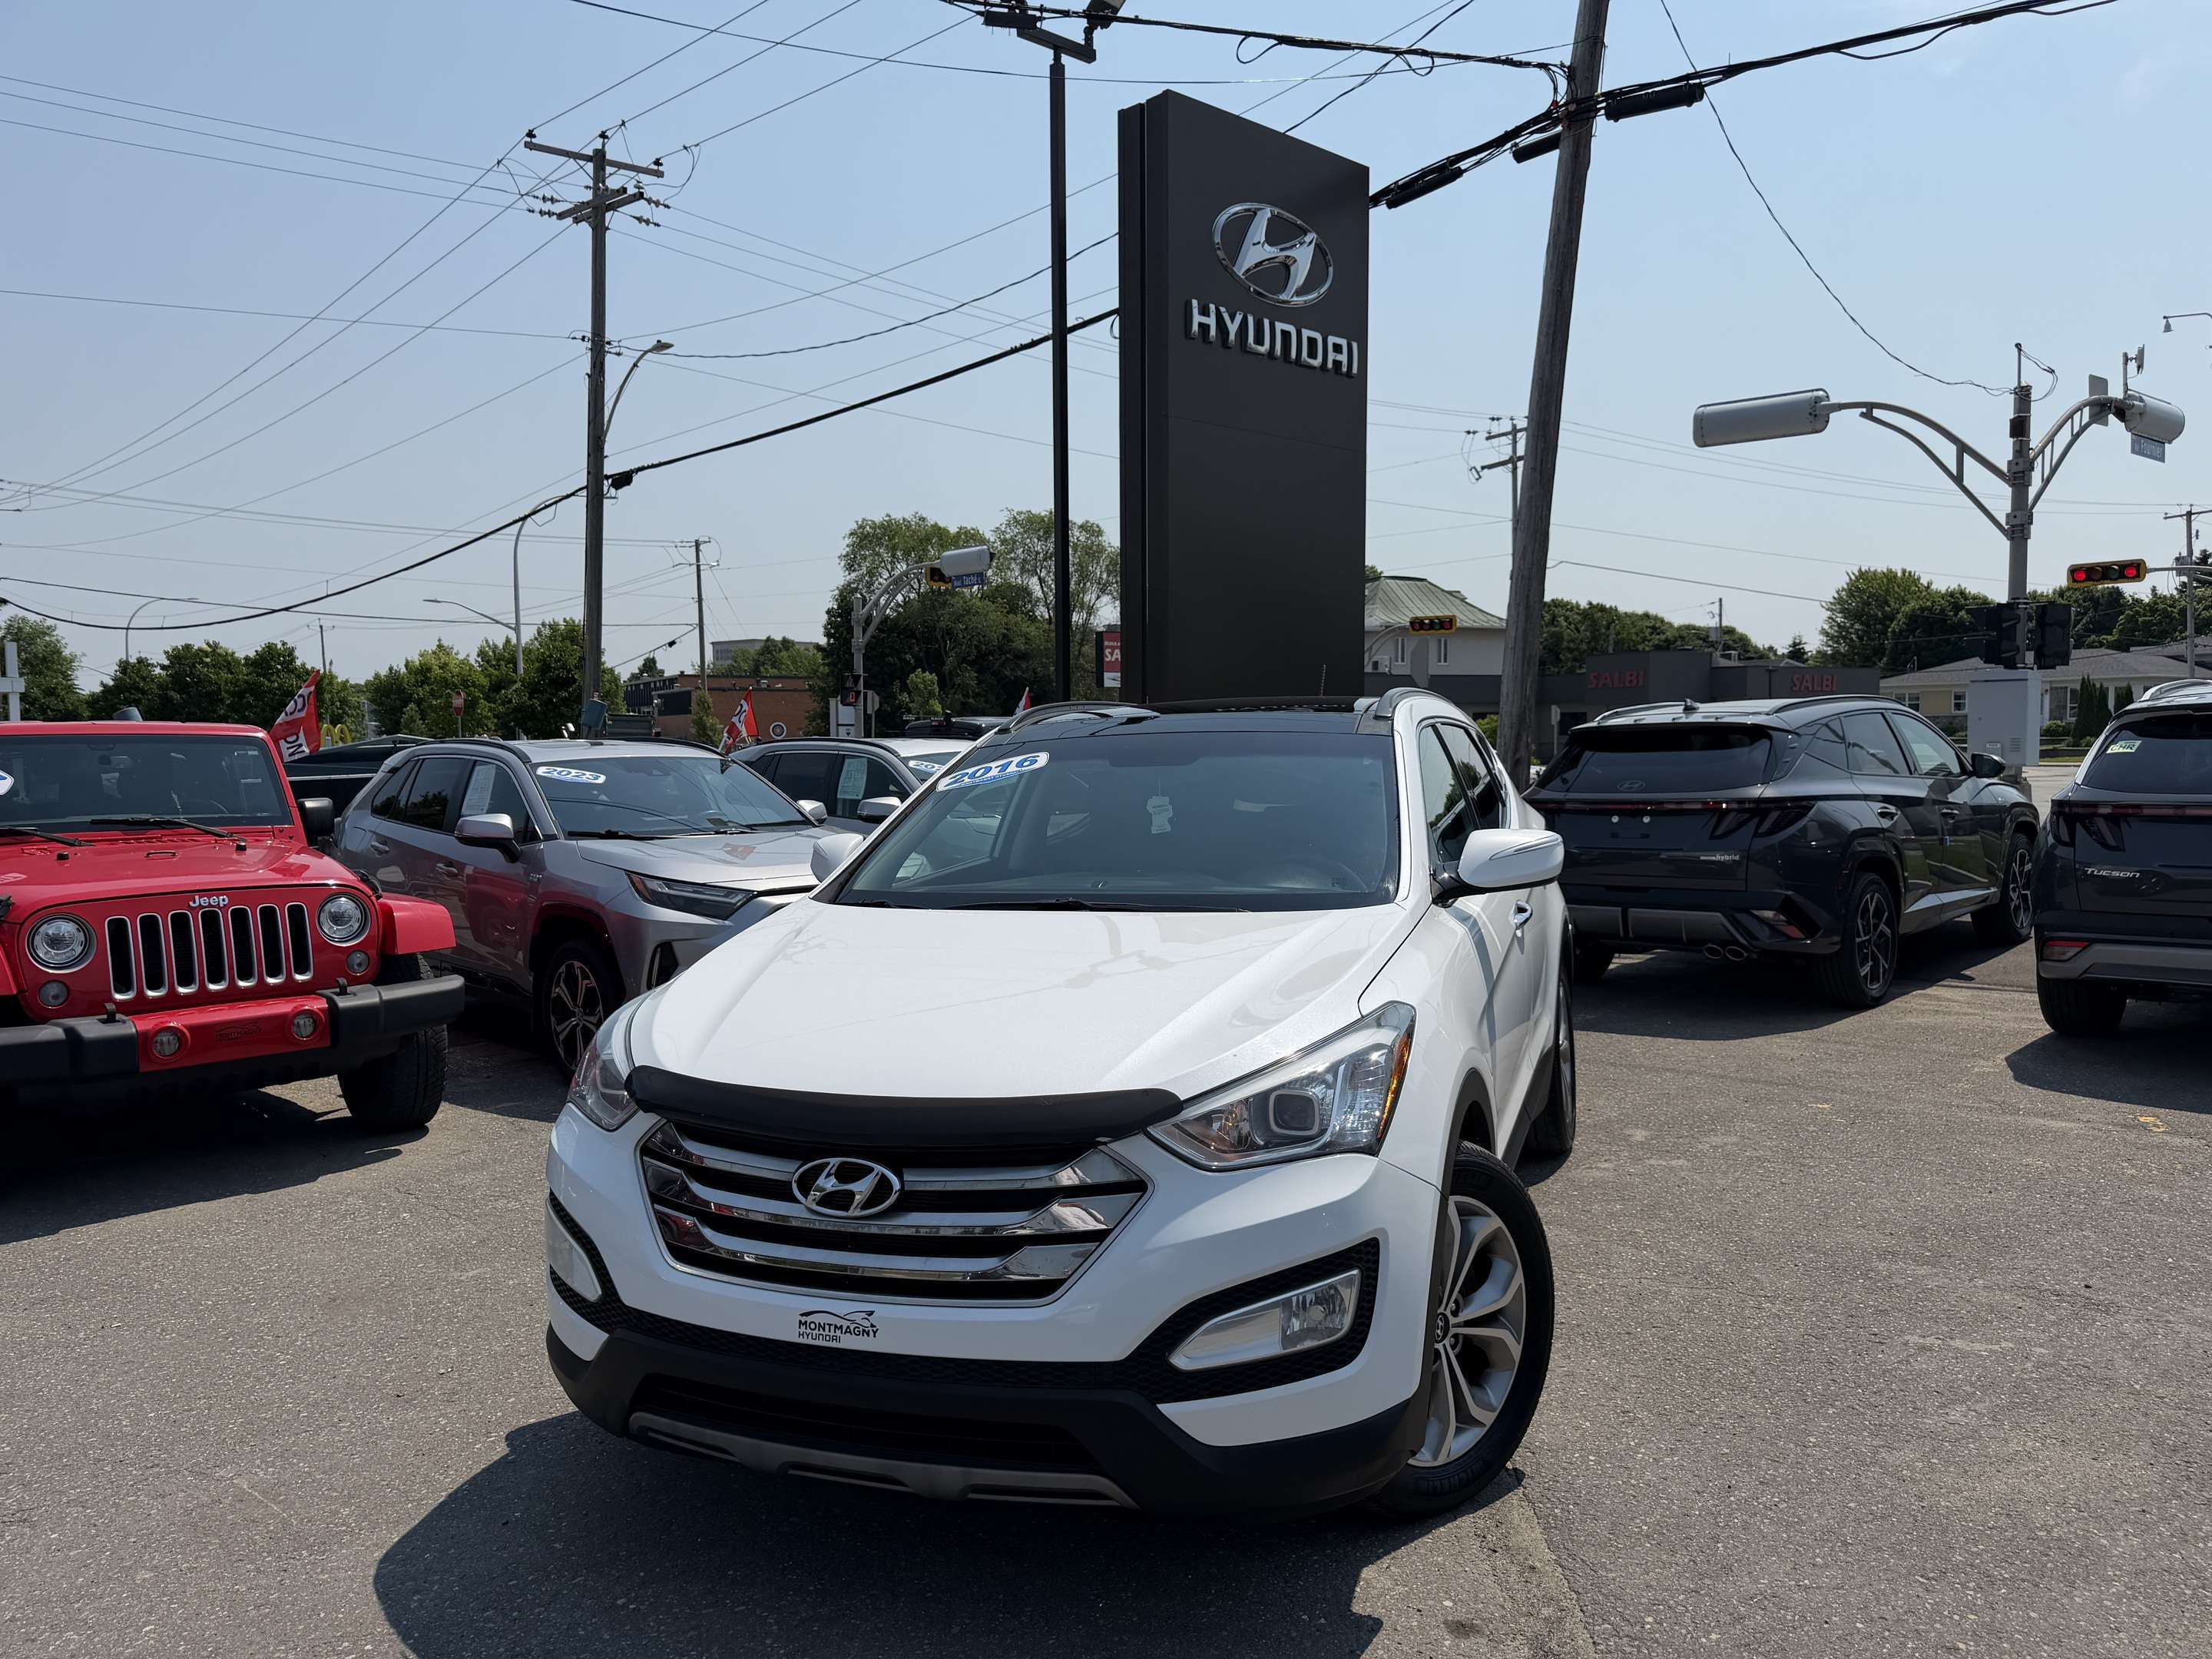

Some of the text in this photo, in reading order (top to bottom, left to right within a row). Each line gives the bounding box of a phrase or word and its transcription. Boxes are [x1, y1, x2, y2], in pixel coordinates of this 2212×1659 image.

[1187, 298, 1359, 376] HYUNDAI
[963, 574, 977, 584] Taché
[1104, 648, 1121, 662] SA
[1588, 670, 1647, 689] SALBI
[1792, 674, 1837, 692] SALBI
[912, 761, 944, 772] 202
[944, 754, 1040, 788] 2016
[541, 767, 601, 781] 2023
[189, 895, 229, 907] Jeep
[798, 1320, 879, 1338] MONTMAGNY
[798, 1331, 841, 1343] HYUNDAI
